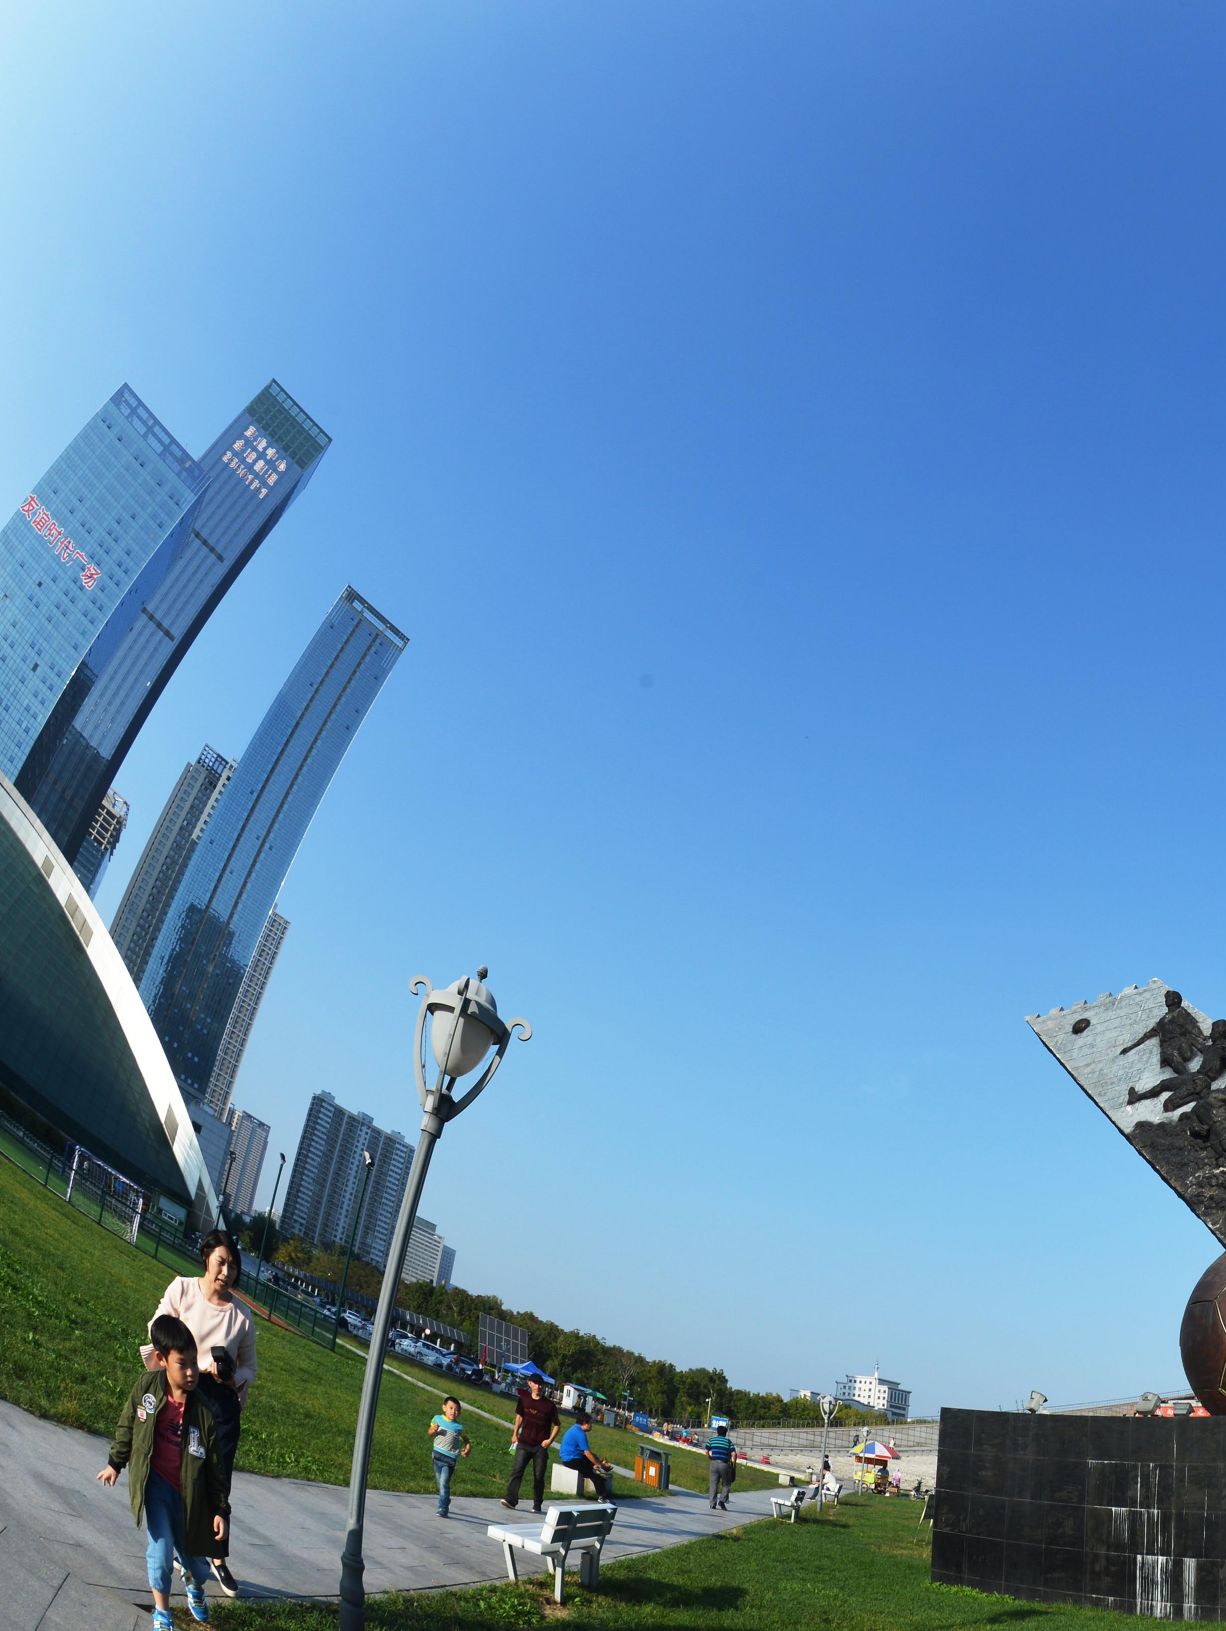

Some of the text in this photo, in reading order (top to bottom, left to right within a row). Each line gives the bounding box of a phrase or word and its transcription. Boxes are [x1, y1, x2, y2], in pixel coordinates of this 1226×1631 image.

[19, 494, 102, 591] 友谊时代广场
[188, 1425, 206, 1459] L
